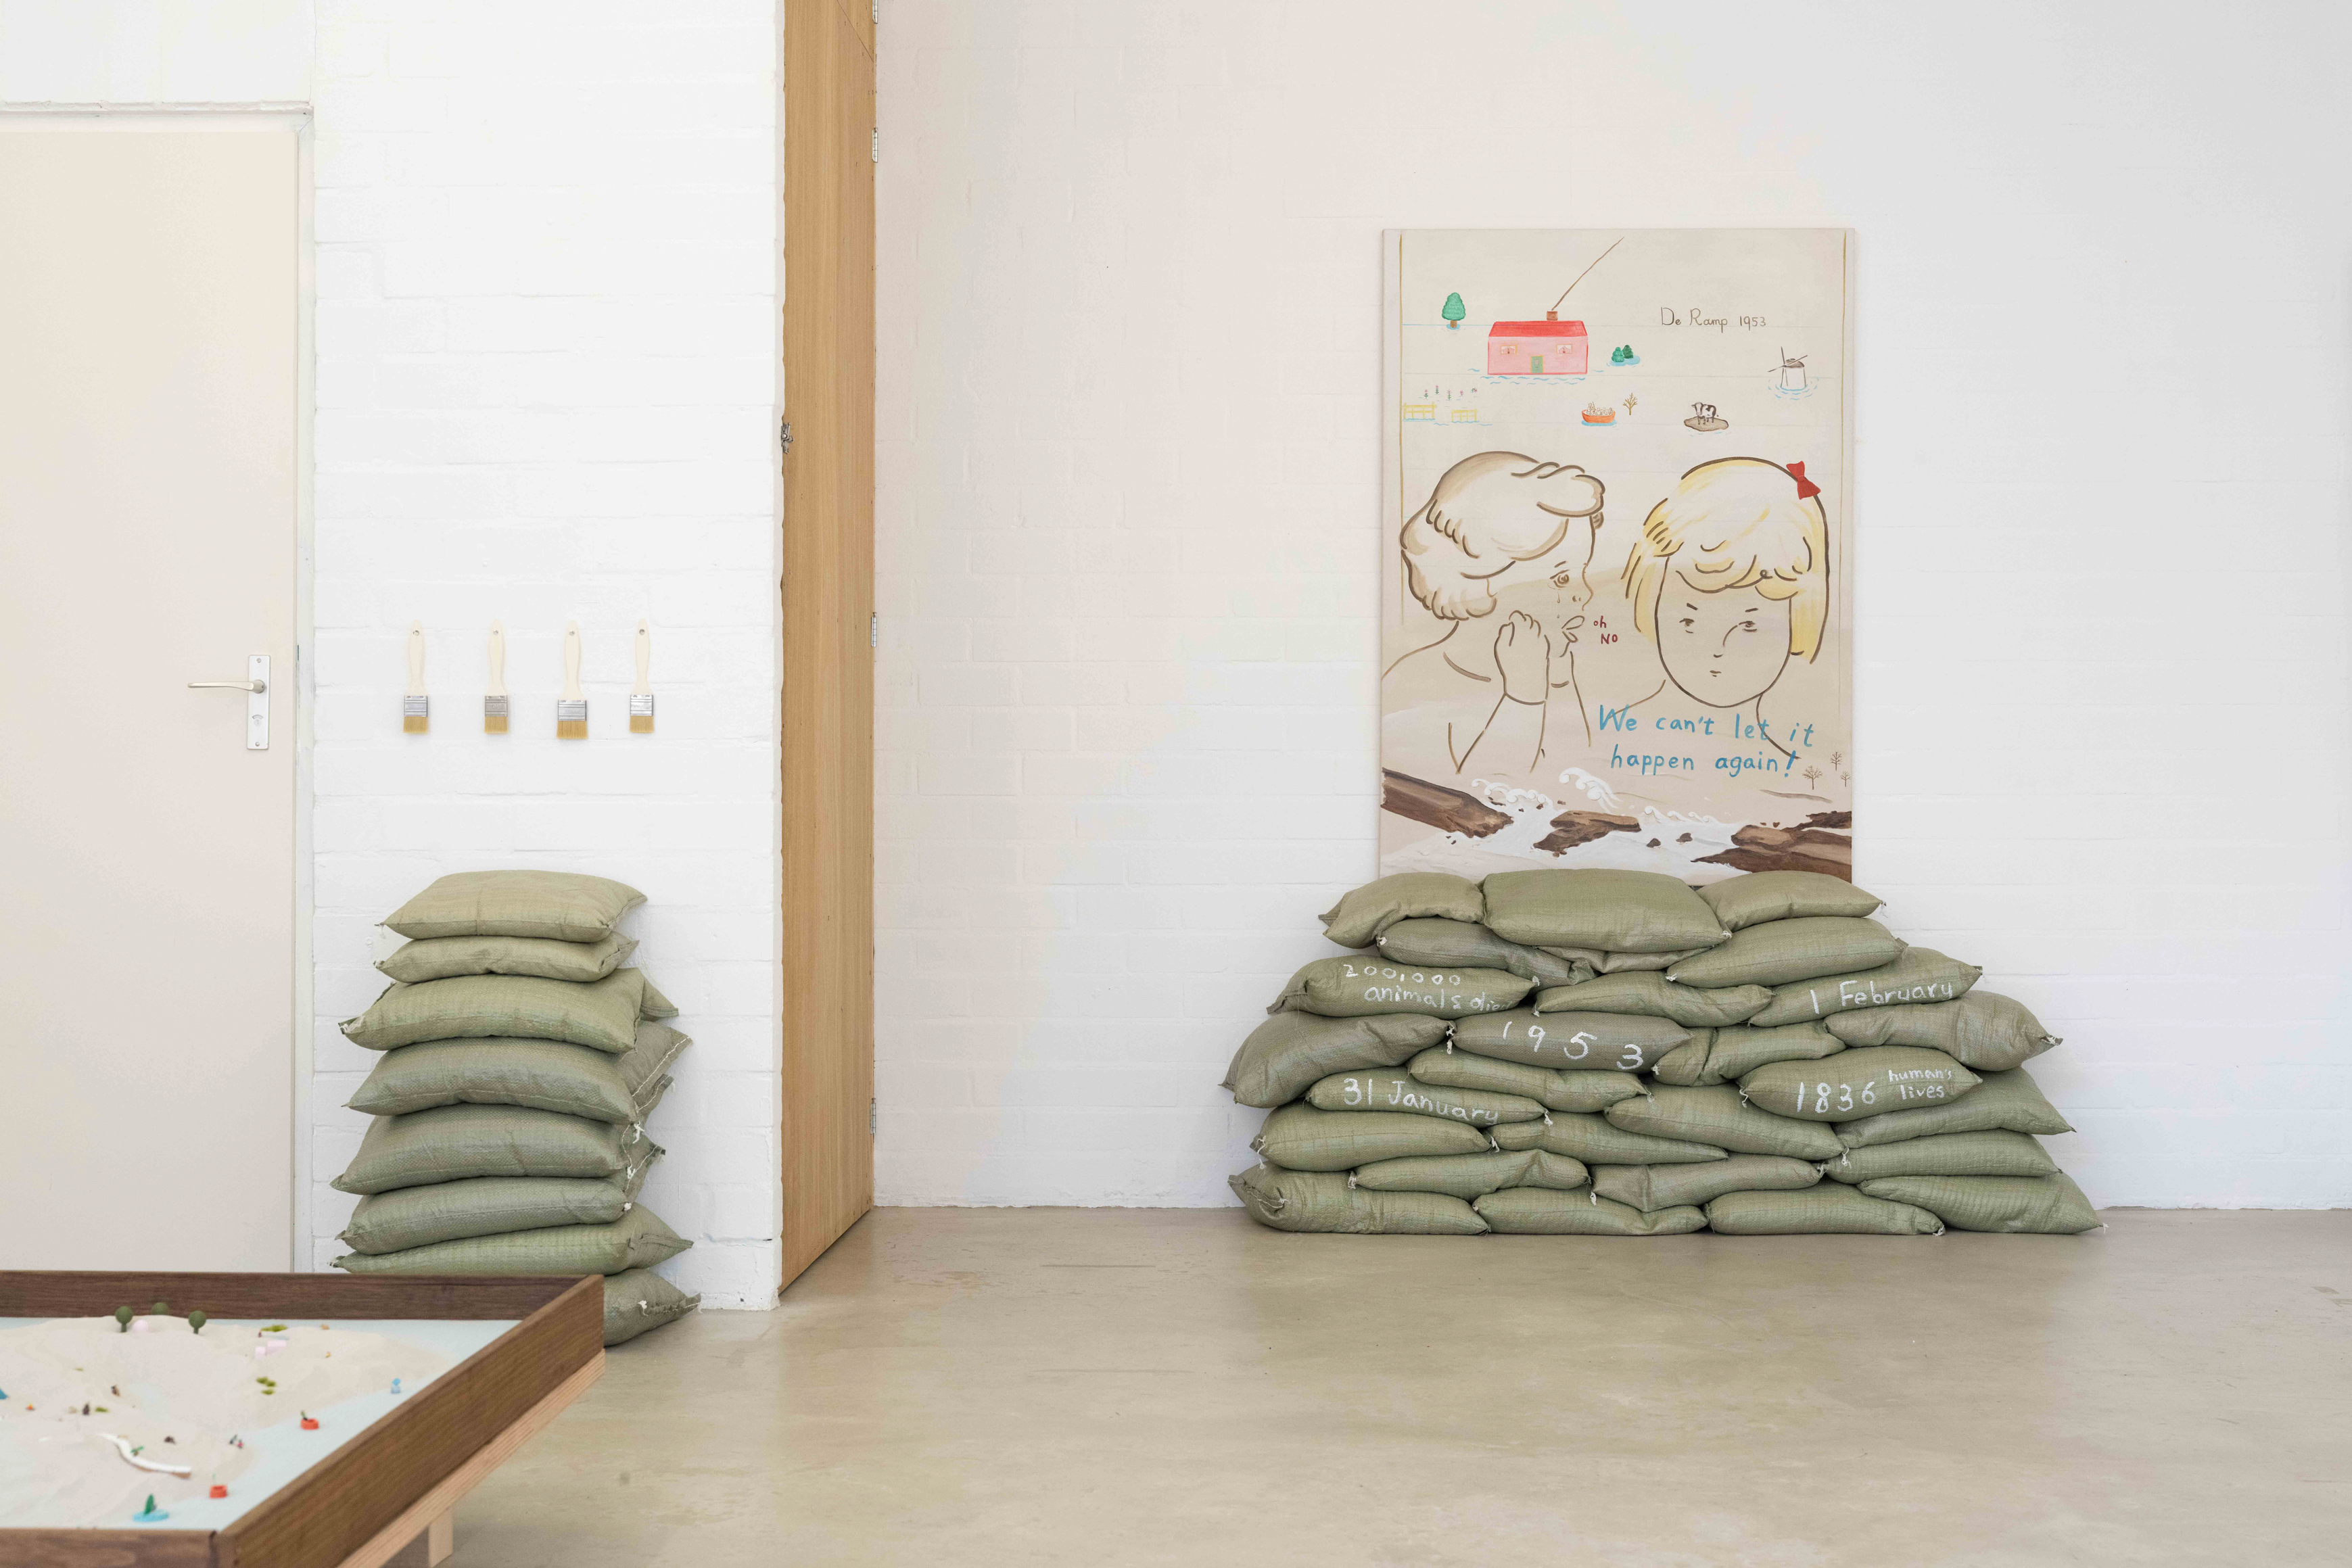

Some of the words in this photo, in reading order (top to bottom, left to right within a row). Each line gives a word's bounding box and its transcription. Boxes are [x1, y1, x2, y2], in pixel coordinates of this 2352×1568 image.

[1660, 306, 1682, 326] De
[1689, 307, 1728, 333] Ramp
[1739, 315, 1767, 331] 1953
[1593, 615, 1607, 629] oh
[1601, 633, 1618, 644] NO
[1599, 704, 1637, 732] We
[1655, 715, 1714, 736] can't
[1735, 713, 1770, 740] let
[1789, 723, 1814, 748] it
[1611, 744, 1695, 776] happen
[1715, 751, 1796, 778] again!
[1364, 986, 1461, 1009] animals
[1810, 990, 1819, 1014] 1
[1839, 980, 1953, 1007] February
[1343, 1078, 1373, 1107] 31
[1388, 1080, 1499, 1125] January
[1797, 1082, 1876, 1113] 1836
[1900, 1085, 1945, 1100] lives
